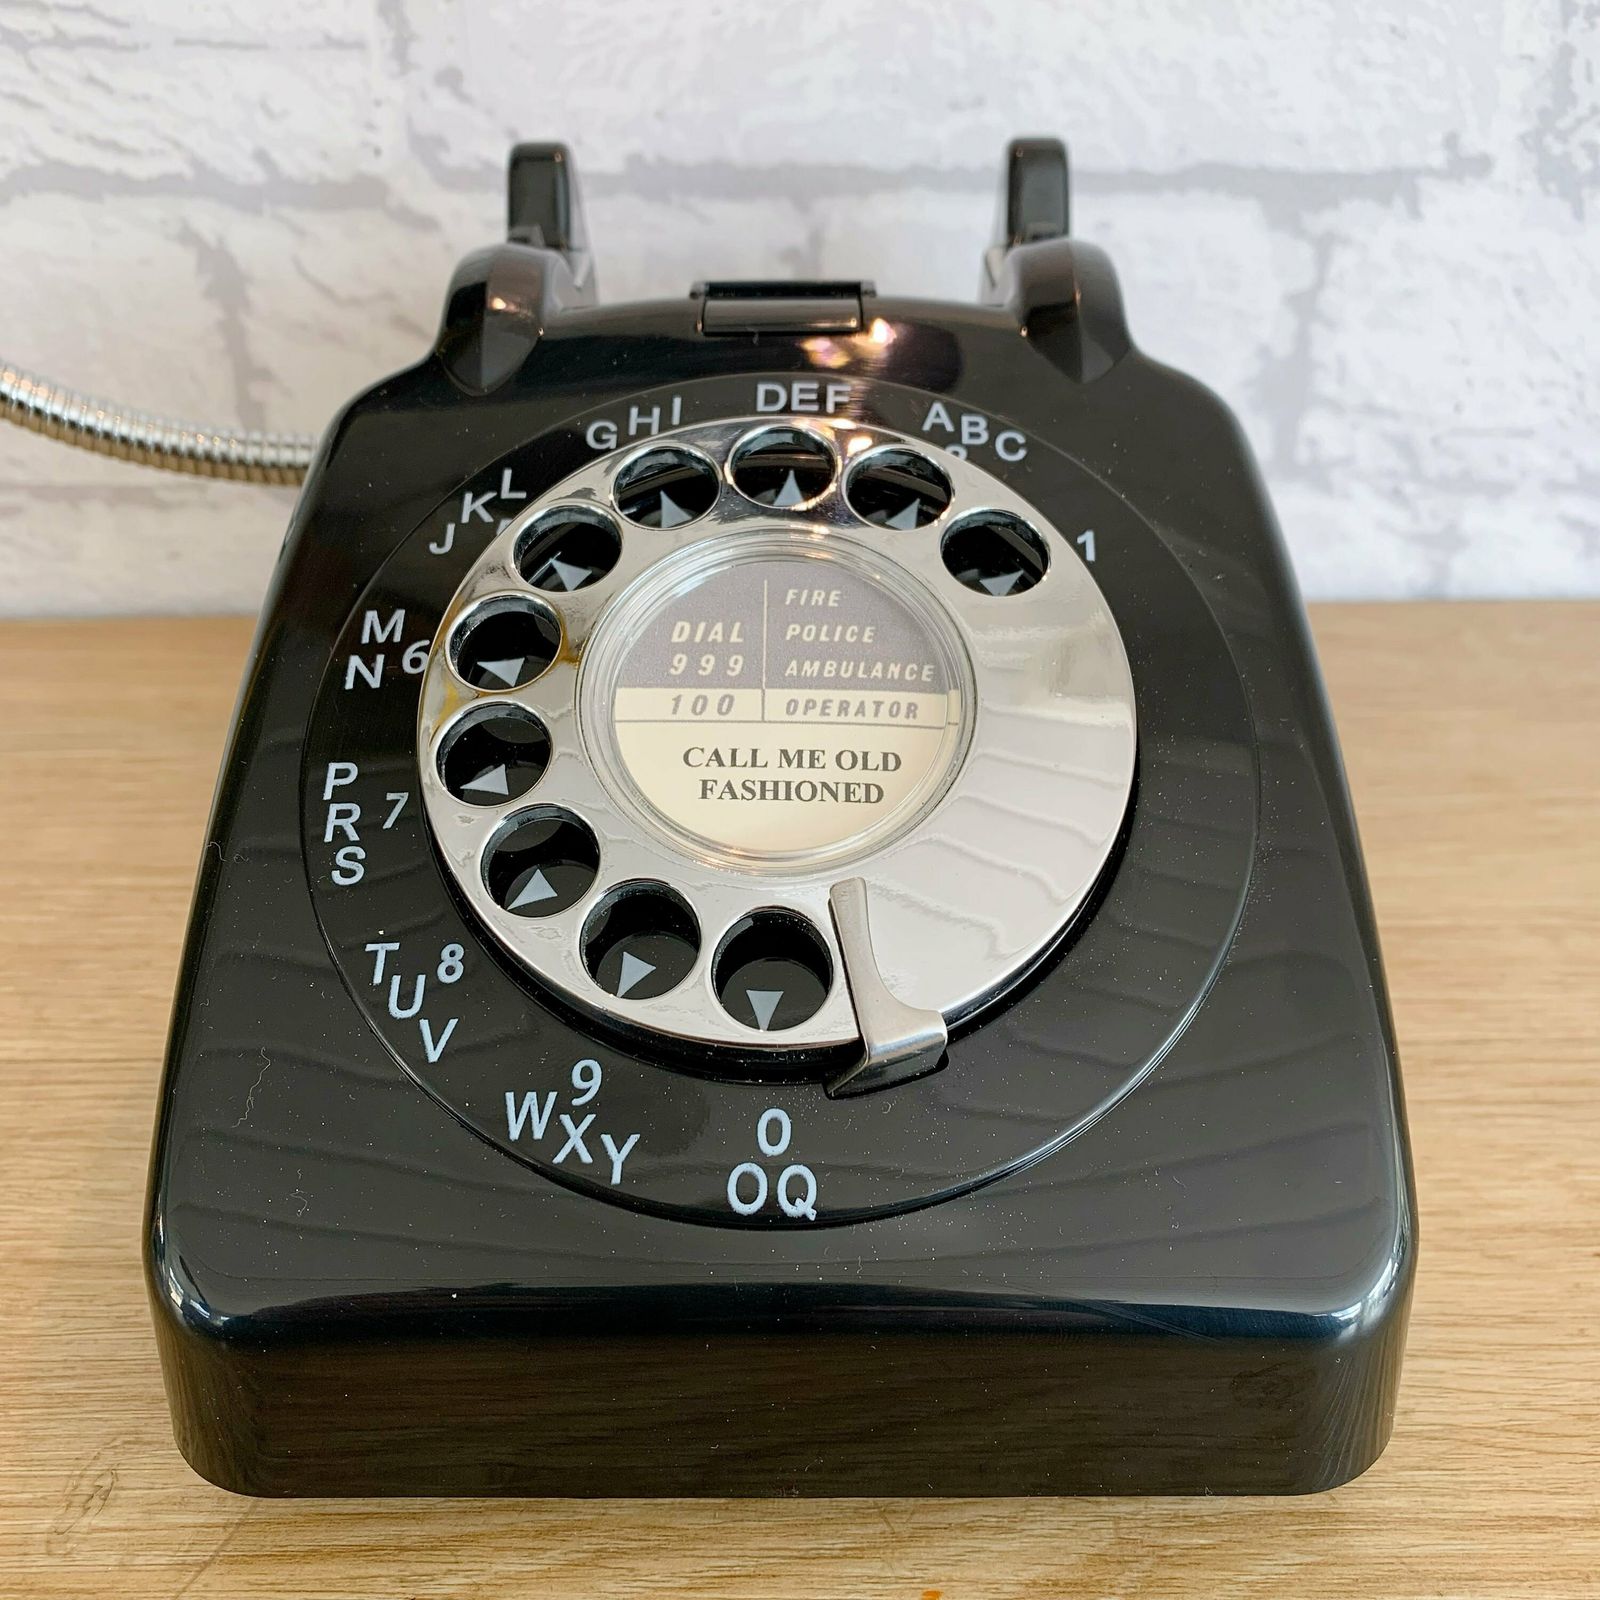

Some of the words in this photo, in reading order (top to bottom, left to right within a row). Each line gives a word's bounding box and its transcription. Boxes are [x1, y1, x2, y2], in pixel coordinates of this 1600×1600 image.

[756, 382, 852, 414] DEF
[586, 397, 682, 450] GHI
[922, 402, 1028, 462] ABC
[1076, 530, 1096, 562] 1
[785, 588, 842, 608] FIRE
[671, 621, 744, 643] DIAL
[785, 624, 876, 643] POLICE
[402, 639, 430, 675] 6
[670, 653, 744, 677] 999
[785, 660, 936, 682] AMBULANCE
[670, 694, 736, 716] 100
[785, 698, 920, 720] OPERATOR
[682, 746, 769, 769] CALL
[777, 748, 826, 770] ME
[835, 750, 902, 773] OLD
[699, 779, 885, 804] FASHIONED
[382, 792, 409, 830] 7
[437, 943, 465, 983] 8
[571, 1059, 602, 1106] 9
[505, 1091, 641, 1185] WXY
[726, 1162, 817, 1221] OQ
